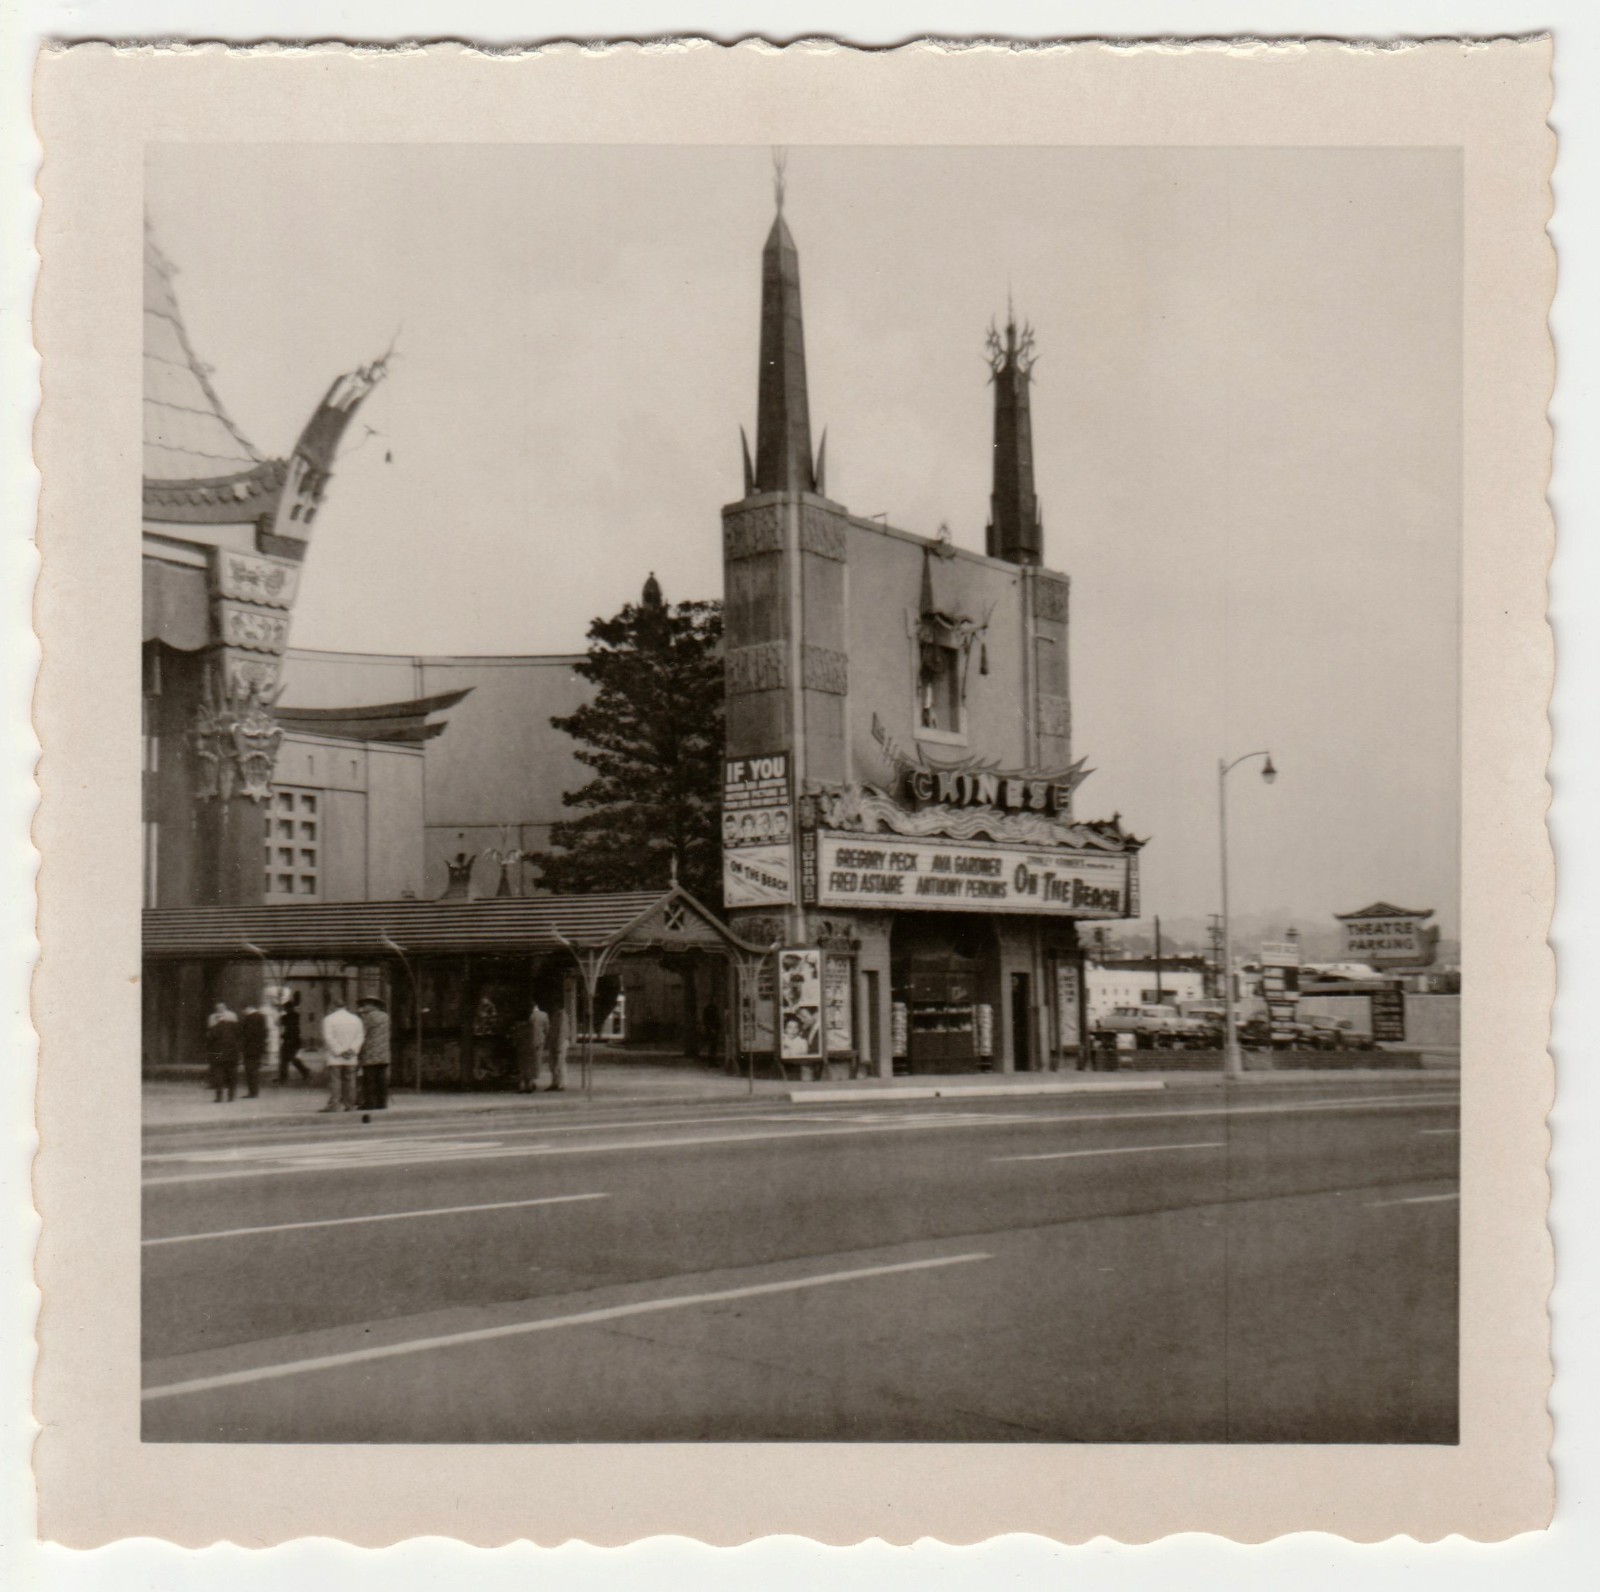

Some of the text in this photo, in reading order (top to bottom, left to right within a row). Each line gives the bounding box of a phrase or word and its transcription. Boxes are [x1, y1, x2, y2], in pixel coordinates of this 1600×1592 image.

[727, 756, 785, 783] IF YOU
[912, 770, 1071, 811] CHINESE
[836, 848, 918, 872] GREGORY PECK
[931, 854, 951, 874] AVA
[954, 855, 1002, 877] GARDNER
[744, 866, 760, 882] THE
[761, 873, 788, 891] BEACH
[829, 871, 904, 895] FRED ASTAIRE
[915, 876, 1007, 899] ANTHONY PERKINS
[1347, 921, 1413, 935] THEATRE
[1348, 938, 1414, 951] PARKING
